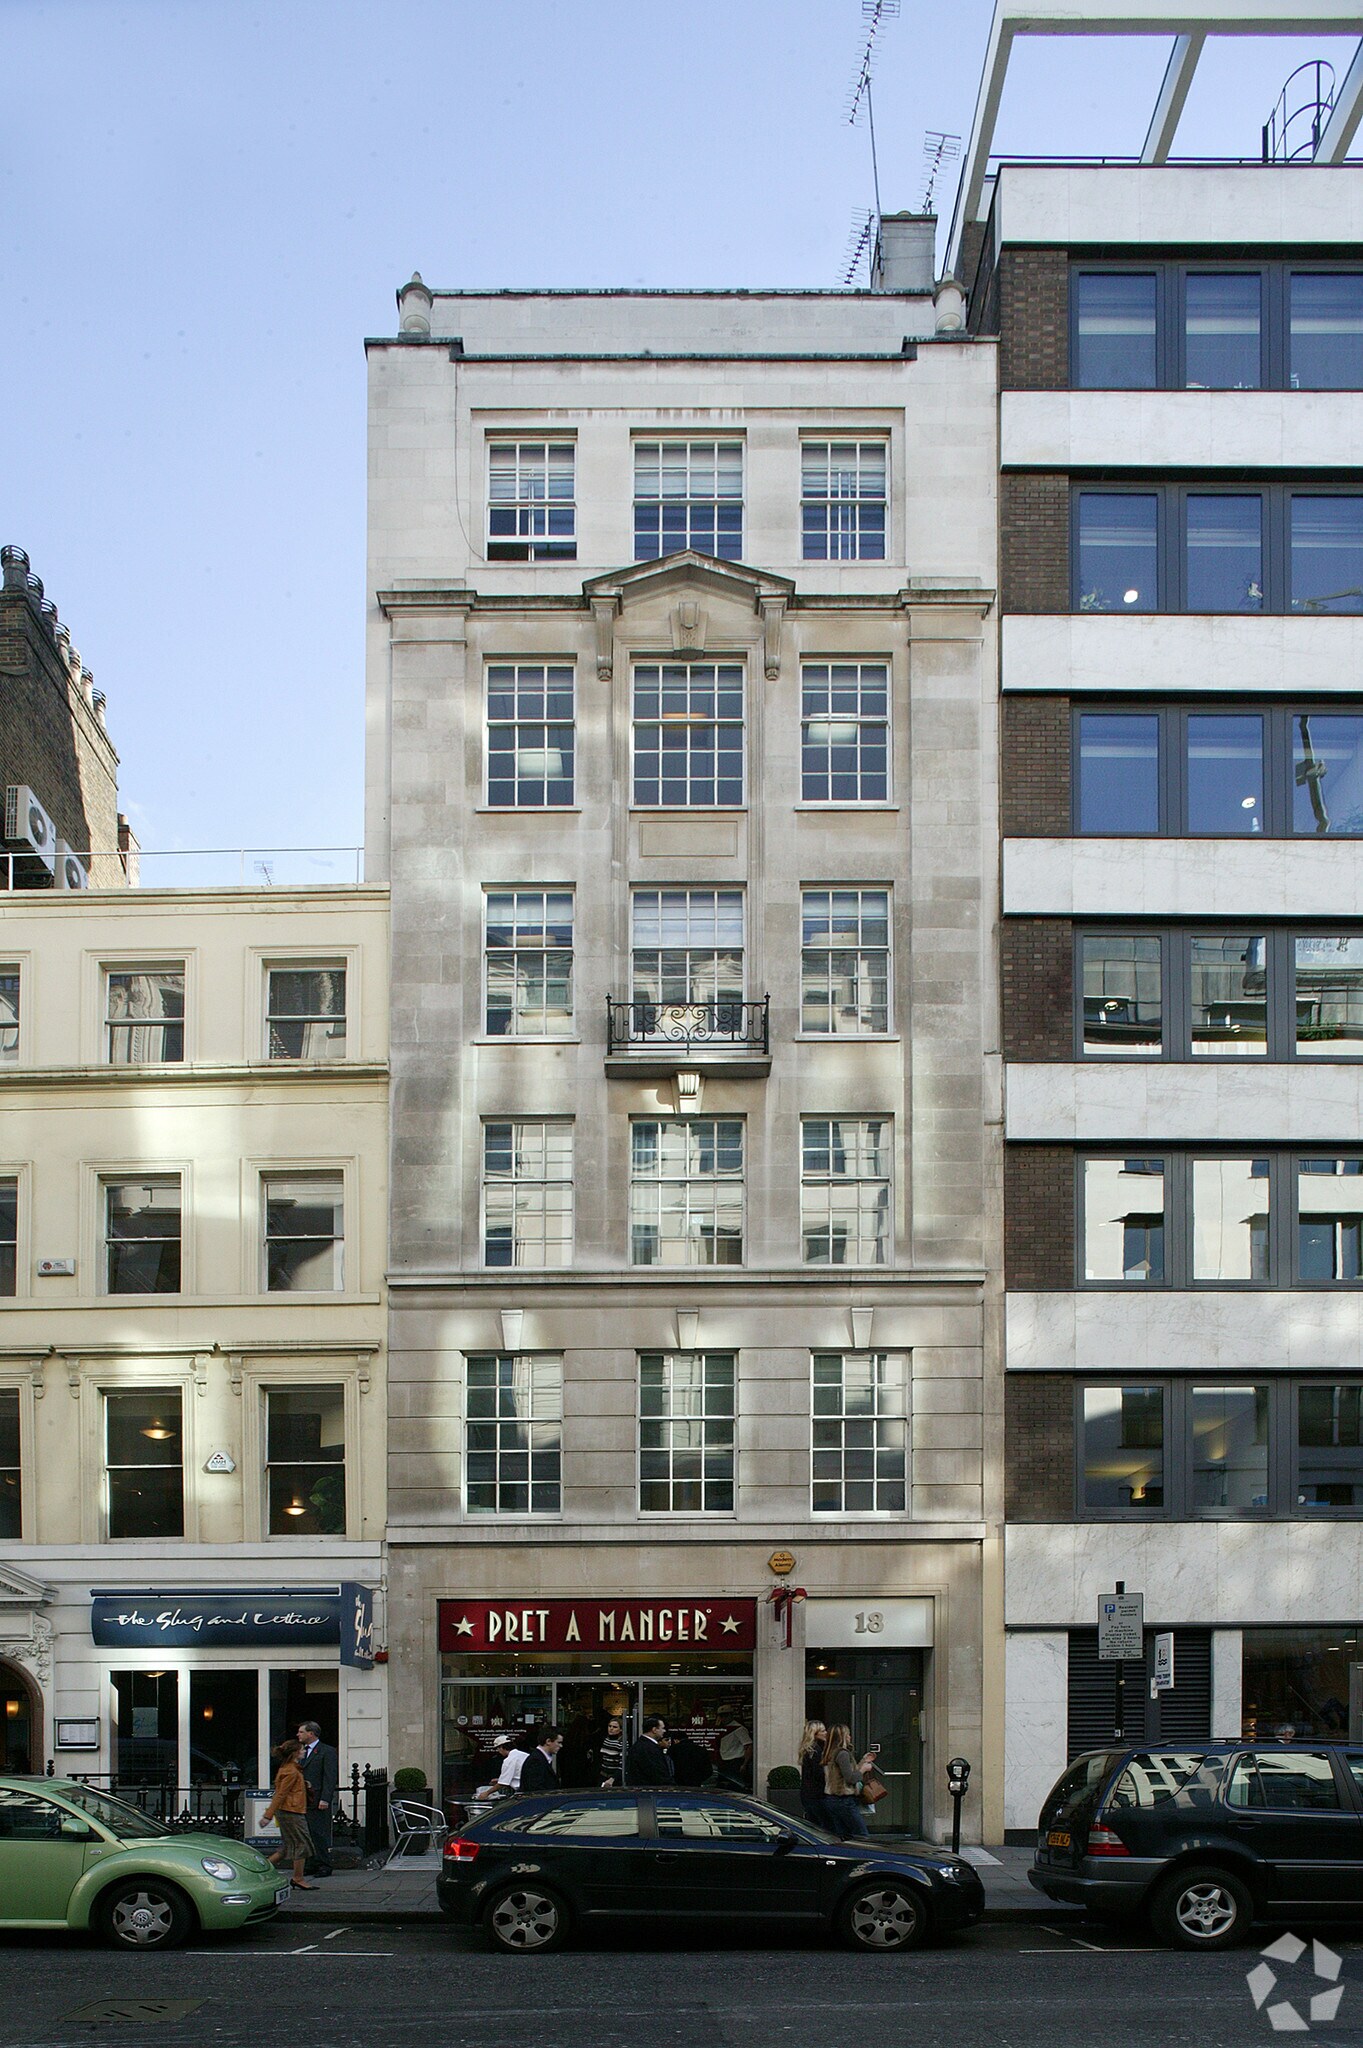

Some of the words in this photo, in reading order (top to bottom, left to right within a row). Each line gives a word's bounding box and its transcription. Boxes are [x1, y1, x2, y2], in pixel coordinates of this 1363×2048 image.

[103, 1611, 153, 1626] the
[156, 1608, 203, 1632] Slug
[207, 1612, 248, 1626] and
[253, 1612, 330, 1626] Lettuce
[488, 1609, 550, 1643] PRET
[565, 1609, 582, 1643] A
[599, 1608, 709, 1643] MANGER
[855, 1611, 885, 1634] 18
